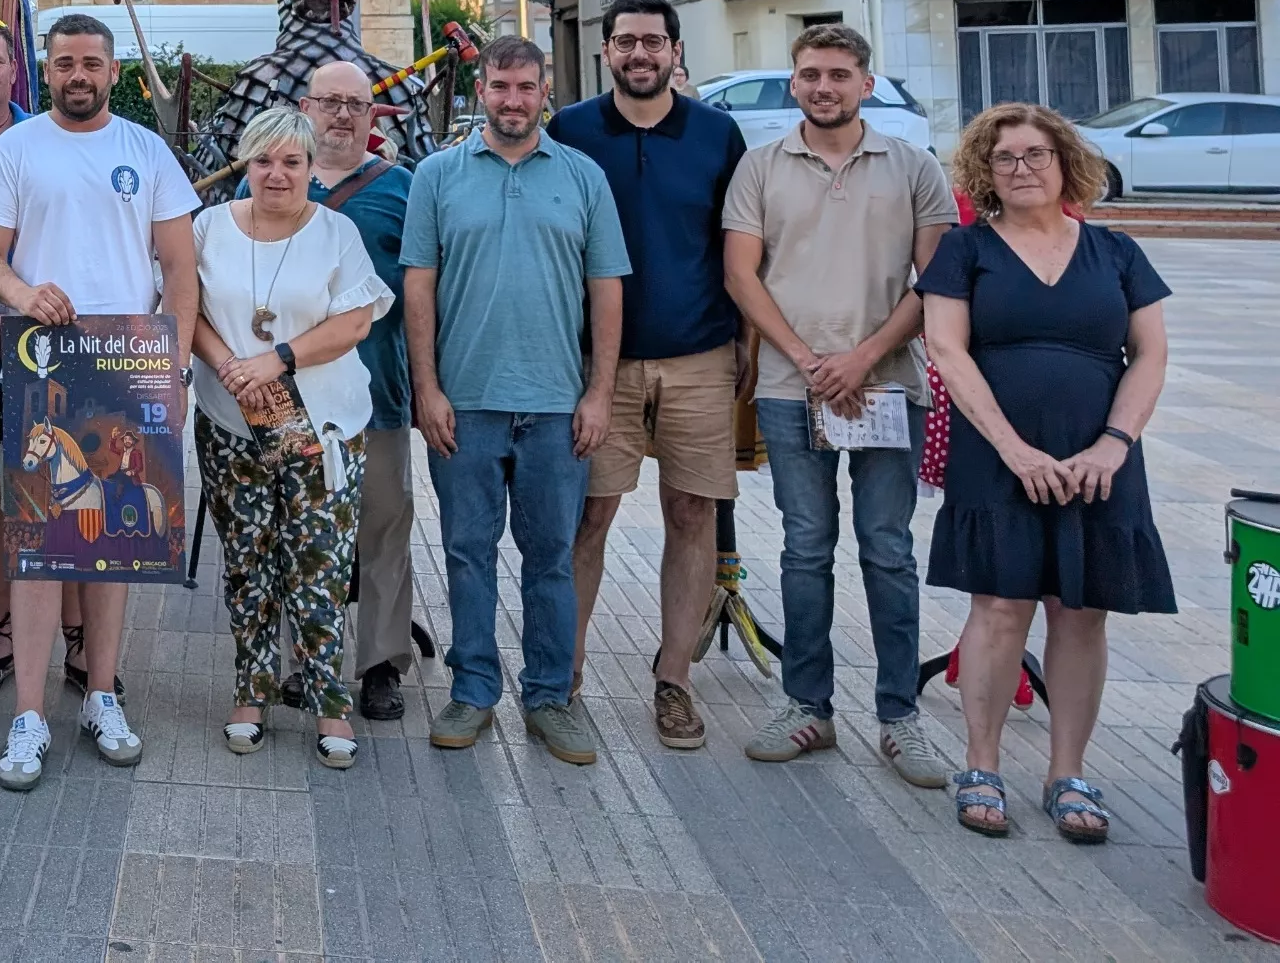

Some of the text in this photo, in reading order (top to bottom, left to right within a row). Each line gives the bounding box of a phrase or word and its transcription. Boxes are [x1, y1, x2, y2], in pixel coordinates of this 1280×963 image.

[60, 334, 169, 354] La Nit del Cavall
[96, 358, 171, 371] RIUDOMS
[141, 403, 167, 423] 19
[137, 426, 172, 434] JULIOL
